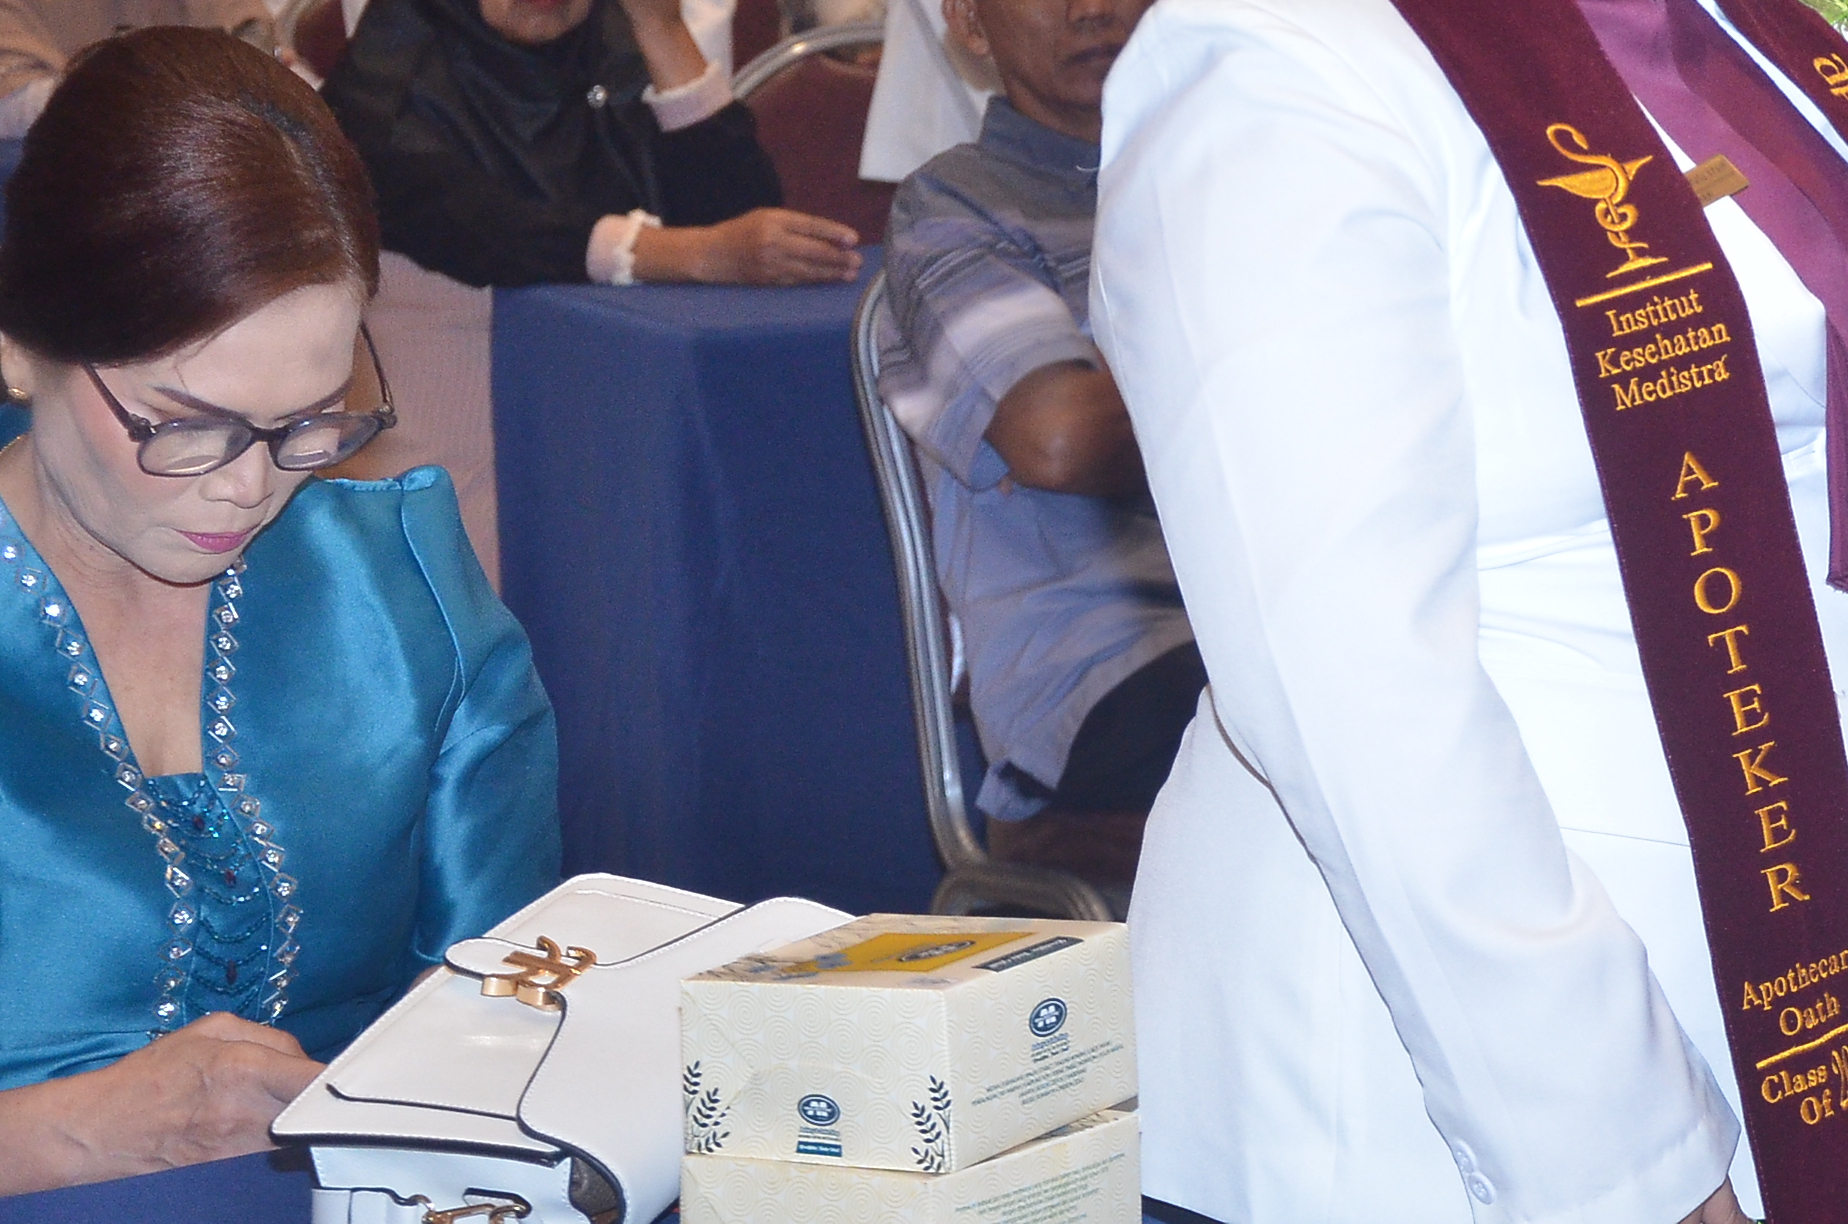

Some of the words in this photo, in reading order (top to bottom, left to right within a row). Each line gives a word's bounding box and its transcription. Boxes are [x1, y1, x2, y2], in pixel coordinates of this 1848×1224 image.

[1605, 288, 1703, 337] Institut
[1595, 323, 1731, 378] Kesehatan
[1611, 353, 1730, 411] Medistra
[1671, 451, 1810, 913] APOTEKER
[1779, 991, 1840, 1036] Oath
[1761, 1064, 1827, 1104] Class
[1800, 1089, 1834, 1125] Of
